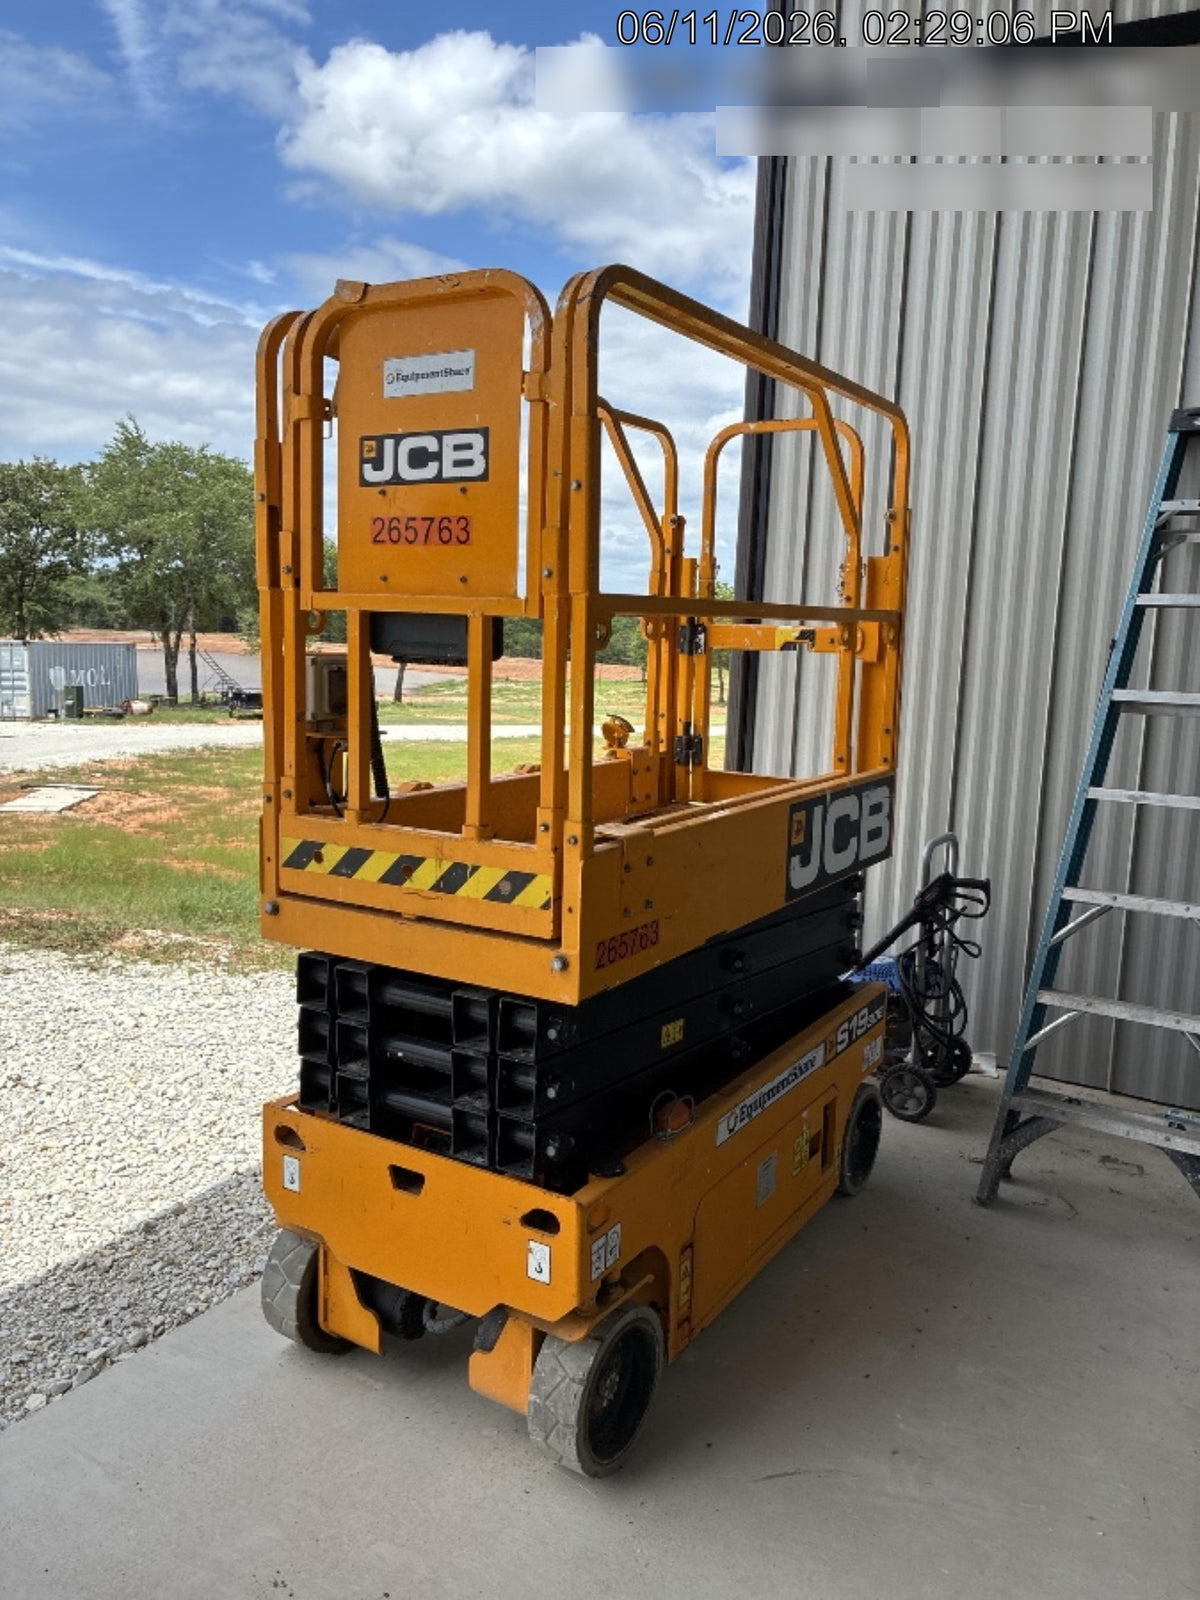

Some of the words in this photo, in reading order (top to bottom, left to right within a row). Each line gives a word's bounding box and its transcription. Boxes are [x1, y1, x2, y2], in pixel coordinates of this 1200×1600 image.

[362, 433, 487, 483] JCB
[372, 515, 471, 545] 265763
[789, 785, 891, 890] JCB
[595, 919, 660, 970] 265763
